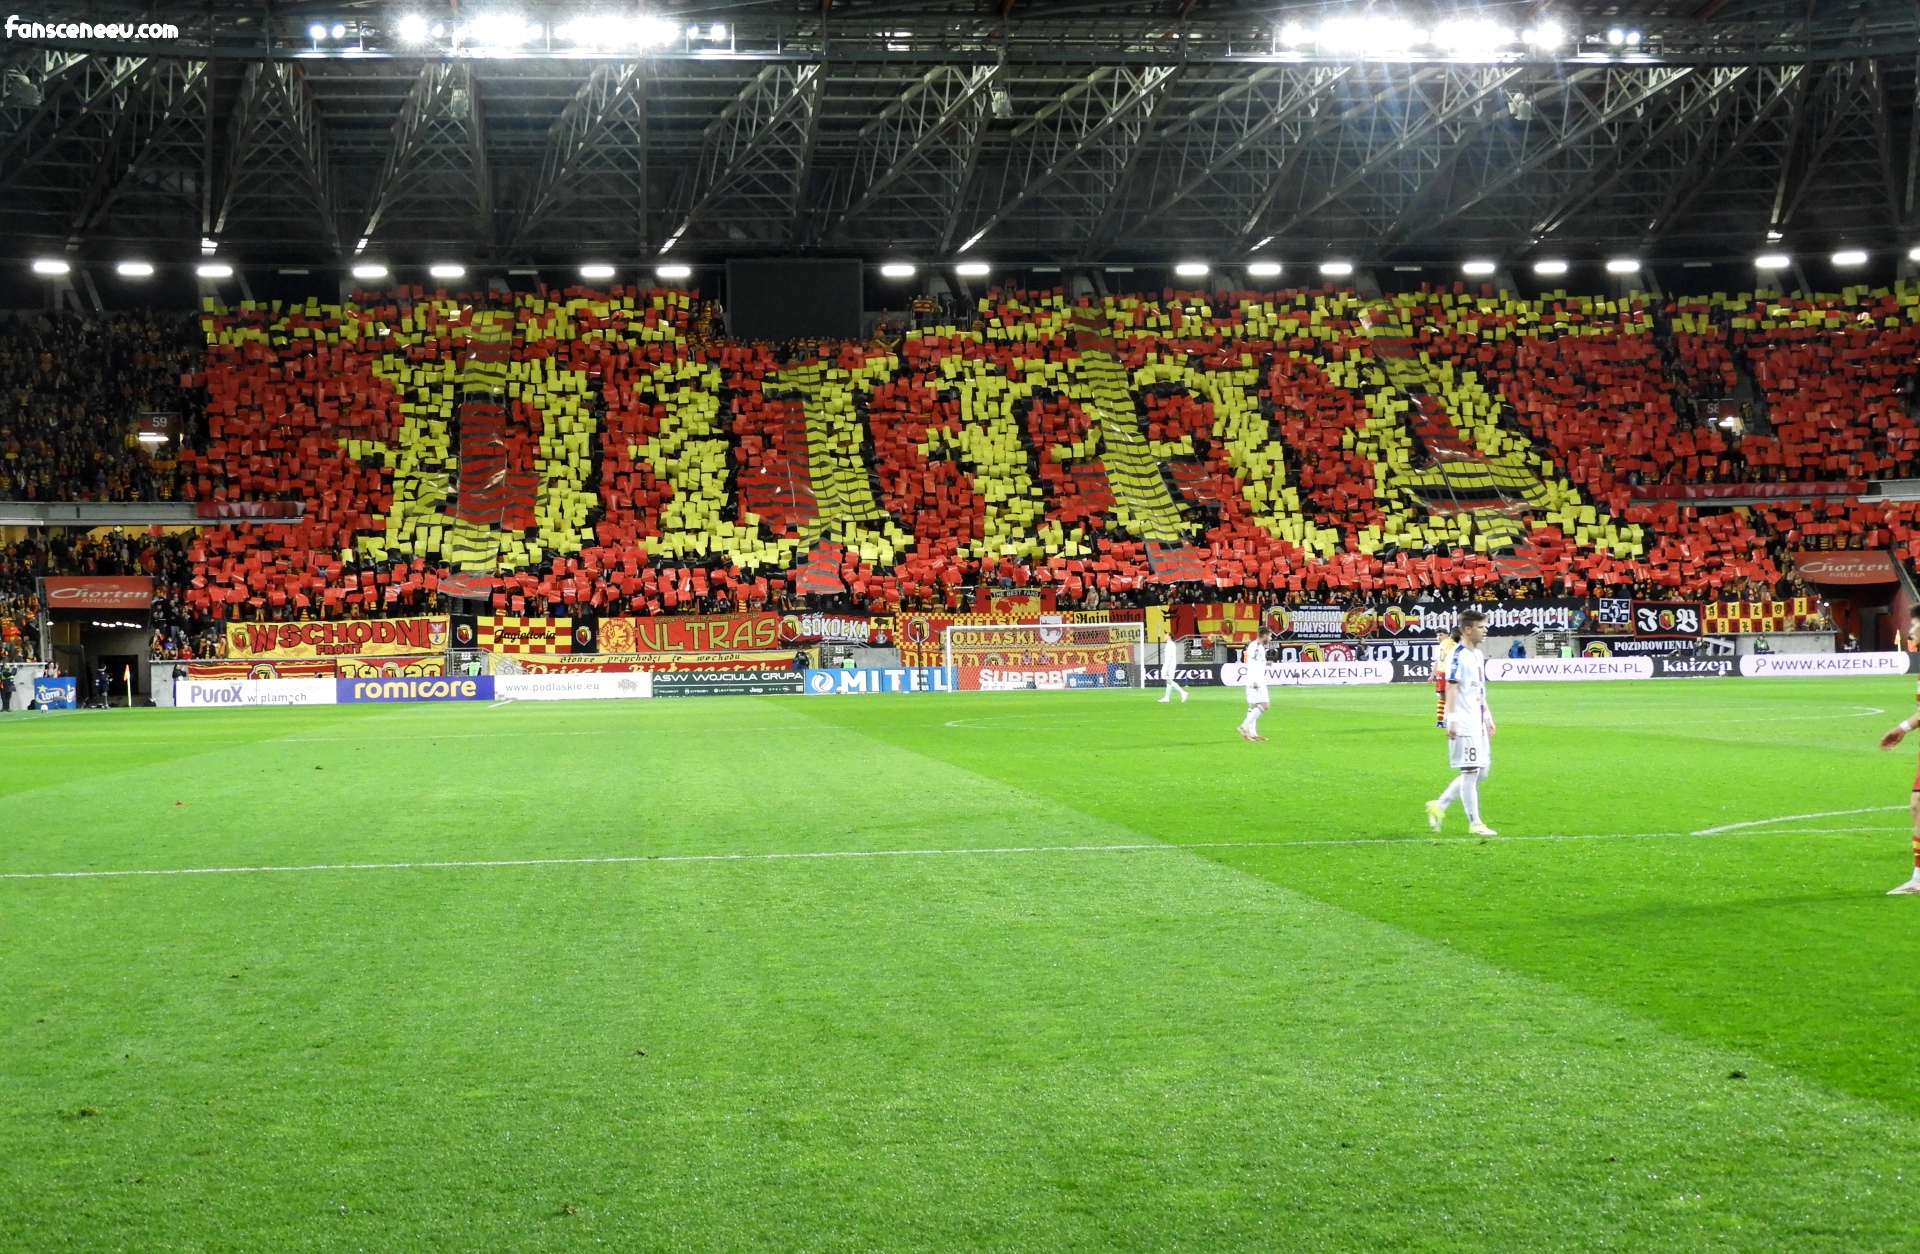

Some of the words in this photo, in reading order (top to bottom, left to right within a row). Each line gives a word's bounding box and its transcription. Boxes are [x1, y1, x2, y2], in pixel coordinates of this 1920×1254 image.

[152, 416, 168, 428] 59
[1800, 561, 1889, 574] Chorten
[50, 587, 149, 599] Chorten
[1206, 605, 1213, 618] J
[1243, 606, 1254, 619] A
[1292, 611, 1345, 622] SPORTOWY
[802, 616, 869, 638] SOKÓŁKA
[953, 616, 1021, 631] BIELSK
[1293, 622, 1343, 633] BIAŁYSTOK
[247, 619, 431, 654] WSCHODNI
[494, 628, 556, 643] Jagiellonia
[639, 618, 776, 651] ULTRAS
[316, 644, 363, 656] FRONT
[1614, 641, 1694, 651] POZDROWIENIA
[1517, 663, 1643, 676] WWW.KAIZEN.PL
[1662, 657, 1733, 673] kaizen
[1770, 658, 1899, 671] WWW.KAIZEN.PL
[653, 674, 689, 682] ASW
[692, 673, 758, 682] WOJCIULA
[761, 671, 804, 681] GRUPA
[841, 668, 949, 693] MITEL
[191, 685, 243, 703] PuroX
[354, 680, 478, 699] romicore
[506, 682, 600, 695] www.podlaskie.eu
[750, 686, 764, 694] Jeep
[261, 692, 307, 704] plamch
